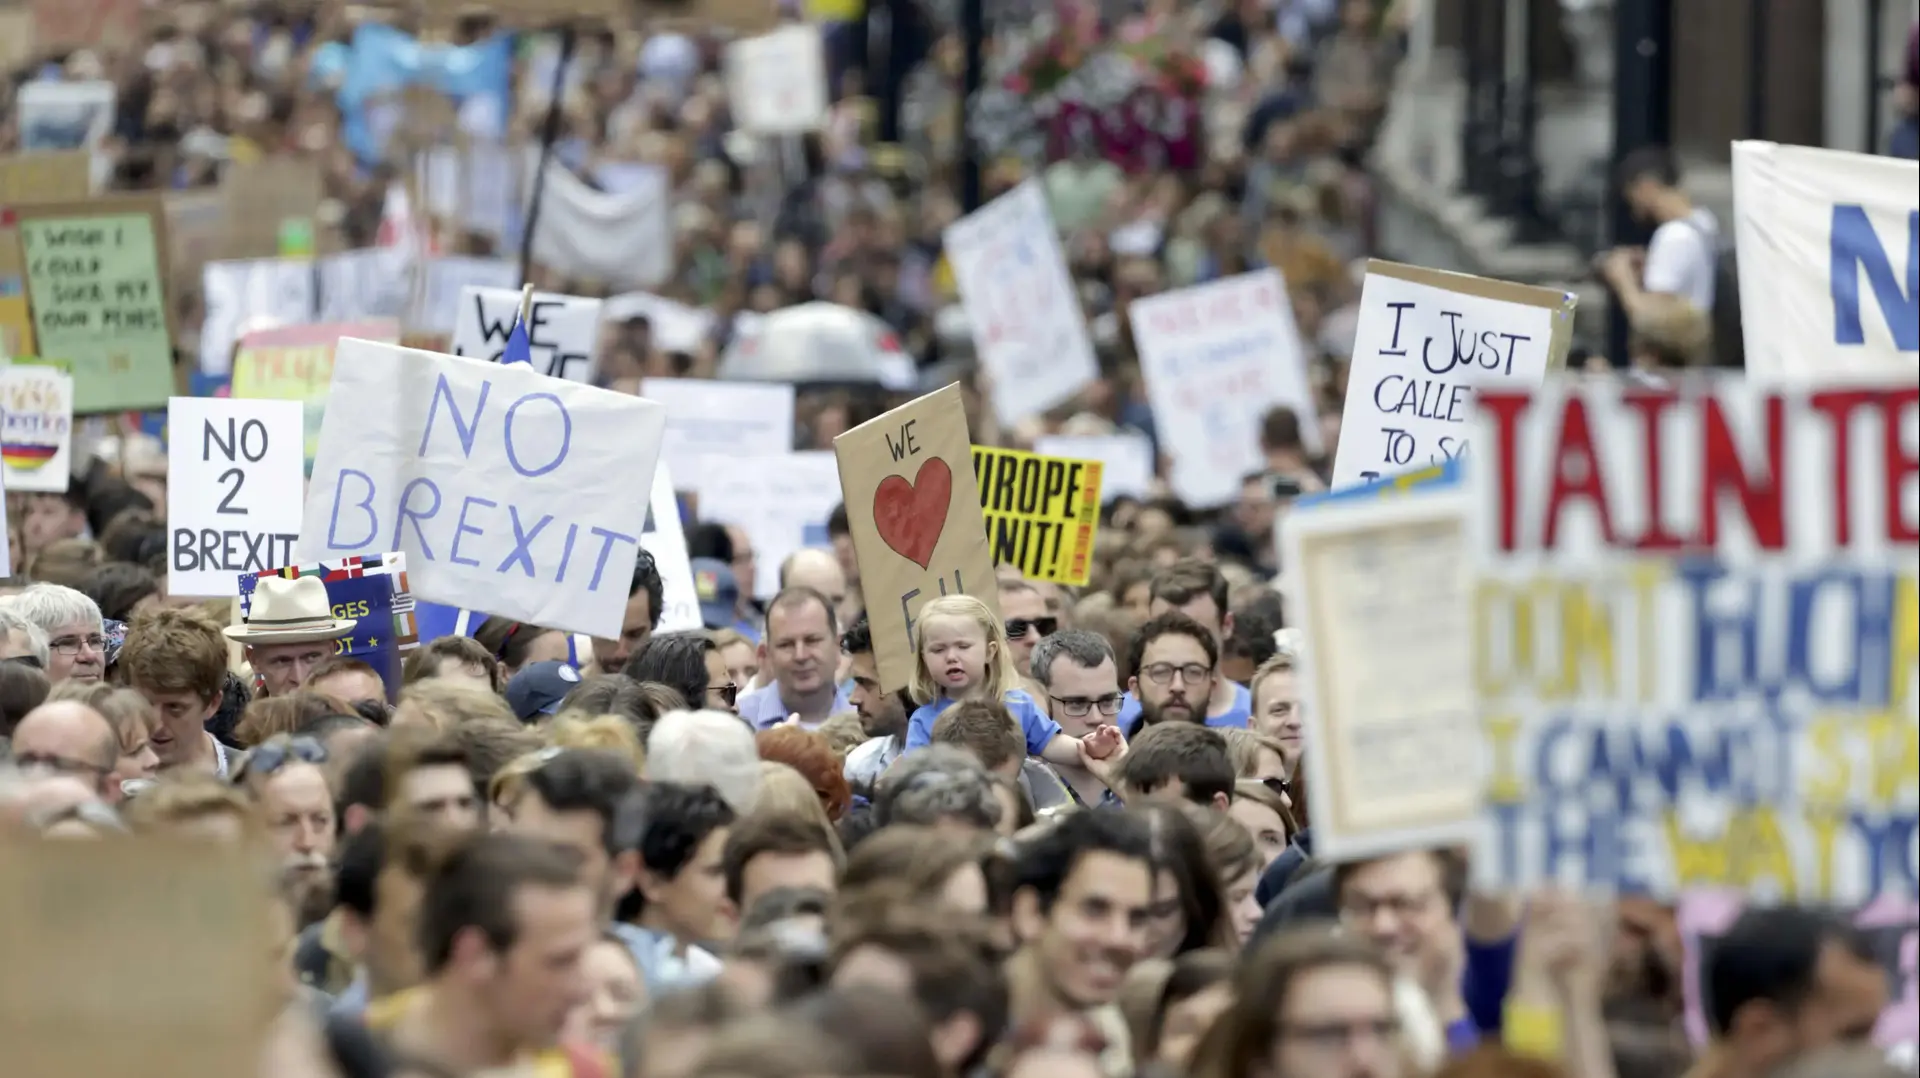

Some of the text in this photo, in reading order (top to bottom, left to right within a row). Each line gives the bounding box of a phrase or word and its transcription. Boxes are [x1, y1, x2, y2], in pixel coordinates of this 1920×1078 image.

[1830, 203, 1919, 352] N
[476, 293, 566, 351] WE
[1379, 302, 1531, 376] I JUST
[203, 417, 268, 463] NO
[418, 372, 572, 478] NO
[885, 419, 921, 462] WE
[1381, 427, 1416, 465] TO
[216, 467, 248, 515] 2
[174, 528, 299, 572] BREXIT
[327, 468, 637, 591] BREXIT
[331, 600, 370, 620] GES
[901, 569, 964, 654] E
